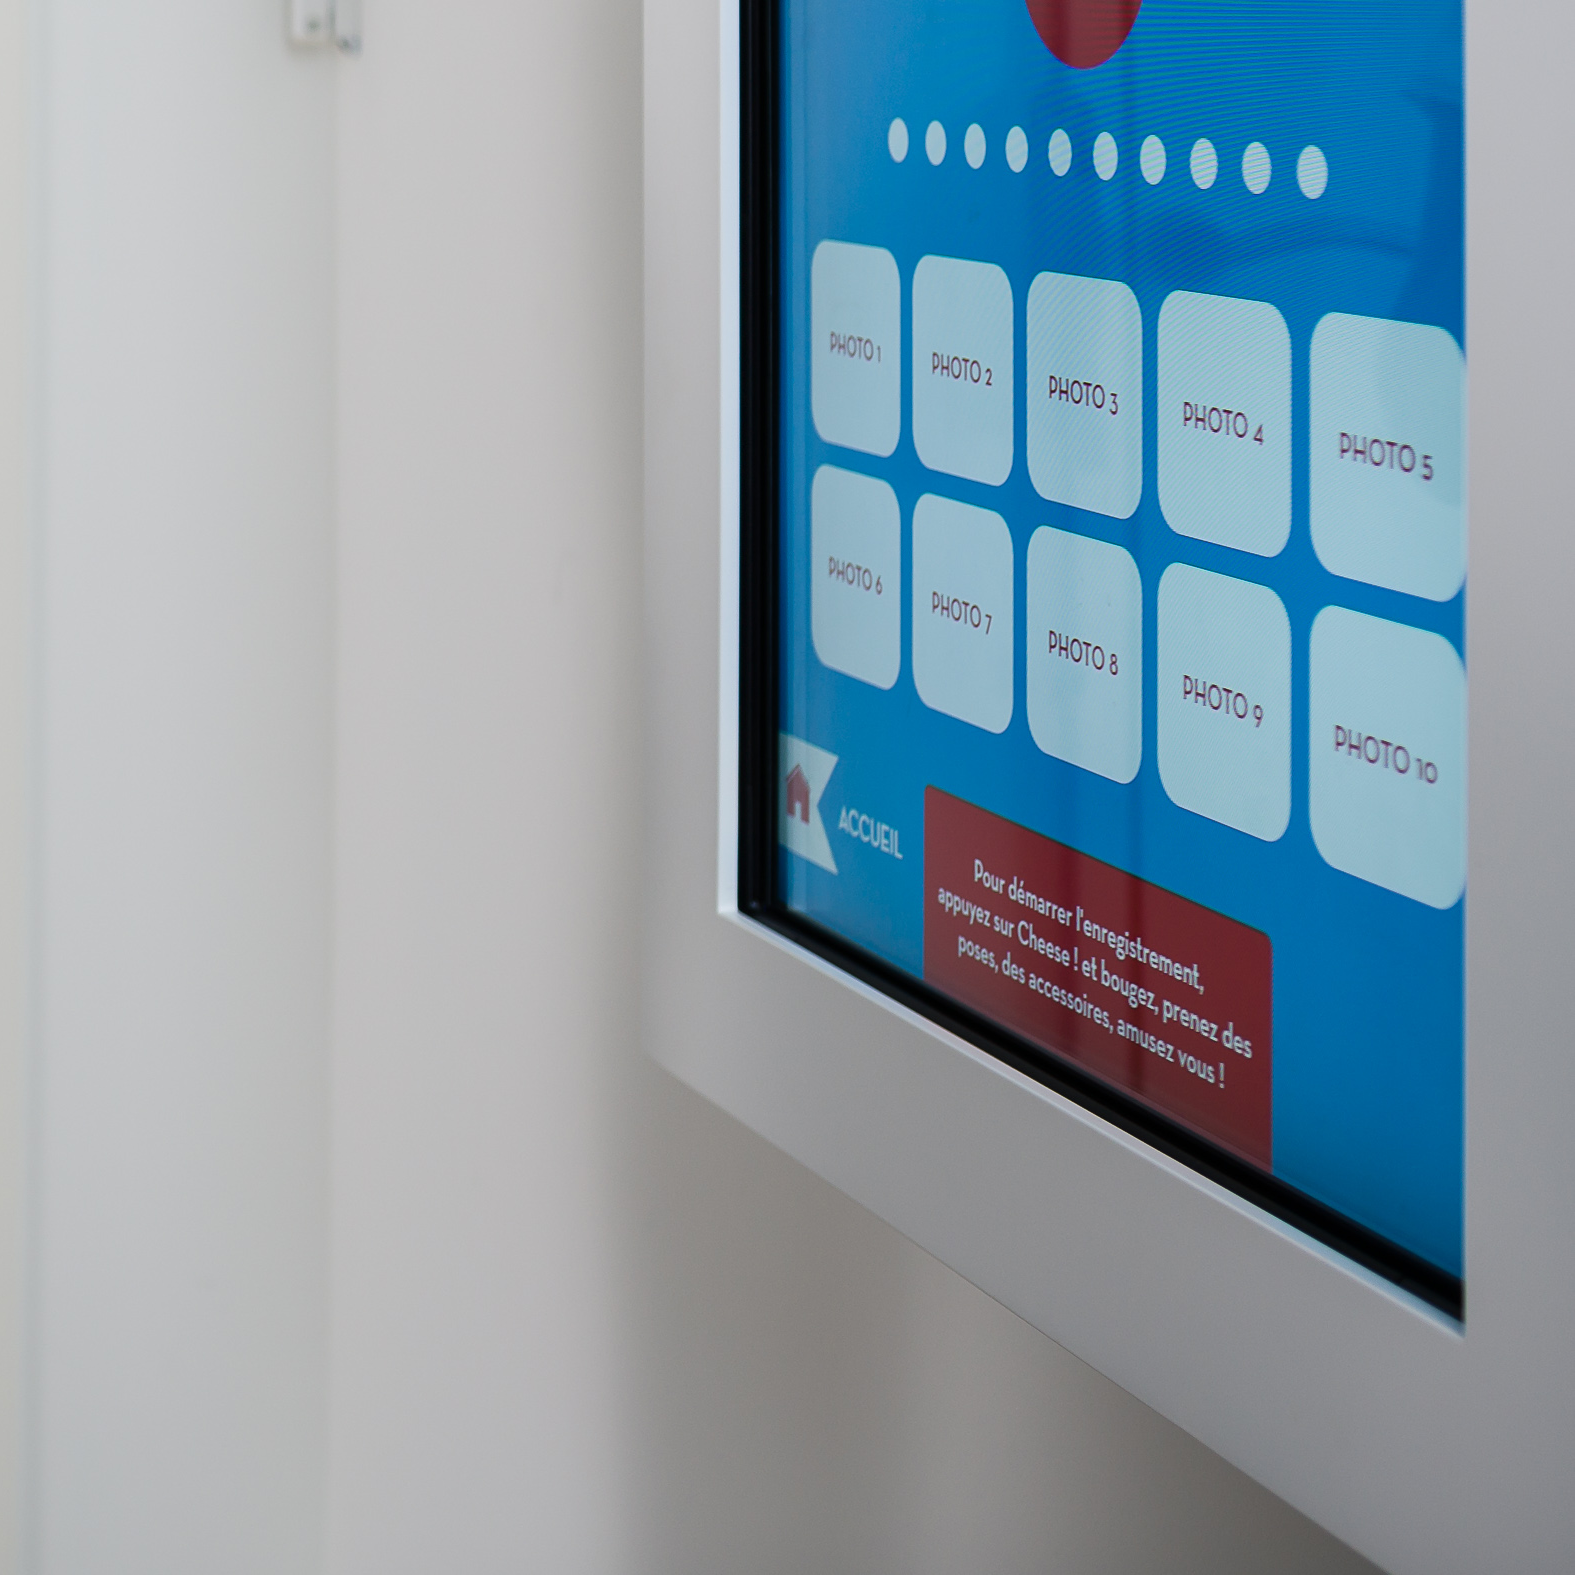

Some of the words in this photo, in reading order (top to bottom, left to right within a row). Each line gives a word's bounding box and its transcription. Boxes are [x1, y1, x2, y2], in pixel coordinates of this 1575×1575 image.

[830, 330, 874, 362] PHOTO
[932, 352, 981, 383] PHOTO
[985, 368, 993, 386] 2
[1048, 375, 1105, 409] PHOTO
[1109, 393, 1119, 415] 3
[1183, 401, 1248, 438] PHOTO
[1253, 424, 1264, 446] 4
[1339, 432, 1416, 473] PHOTO
[1422, 455, 1434, 481] 5
[828, 556, 873, 592] PHOTO
[876, 575, 883, 595] 6
[932, 591, 981, 628] PHOTO
[985, 614, 993, 635] 7
[1048, 629, 1105, 670] PHOTO
[1109, 653, 1119, 675] 8
[1183, 674, 1248, 719] PHOTO
[1253, 704, 1264, 728] 9
[1334, 724, 1410, 774] PHOTO
[1416, 758, 1438, 784] 10
[838, 805, 904, 861] ACCUEIL
[974, 858, 1005, 894] Pour
[1008, 876, 1072, 926] démarrer
[1076, 906, 1204, 995] l'enregistrement,
[938, 887, 990, 927] appuyez
[993, 915, 1014, 938] sur
[1017, 920, 1070, 967] Cheese
[1082, 957, 1098, 981] et
[1101, 958, 1159, 1015] bougez,
[1162, 999, 1218, 1042] prenez
[1222, 1022, 1252, 1058] des
[958, 935, 998, 973] poses,
[1002, 951, 1025, 984] des
[1029, 973, 1113, 1034] accessoires,
[1117, 1019, 1175, 1062] amusez
[1177, 1049, 1215, 1084] vous
